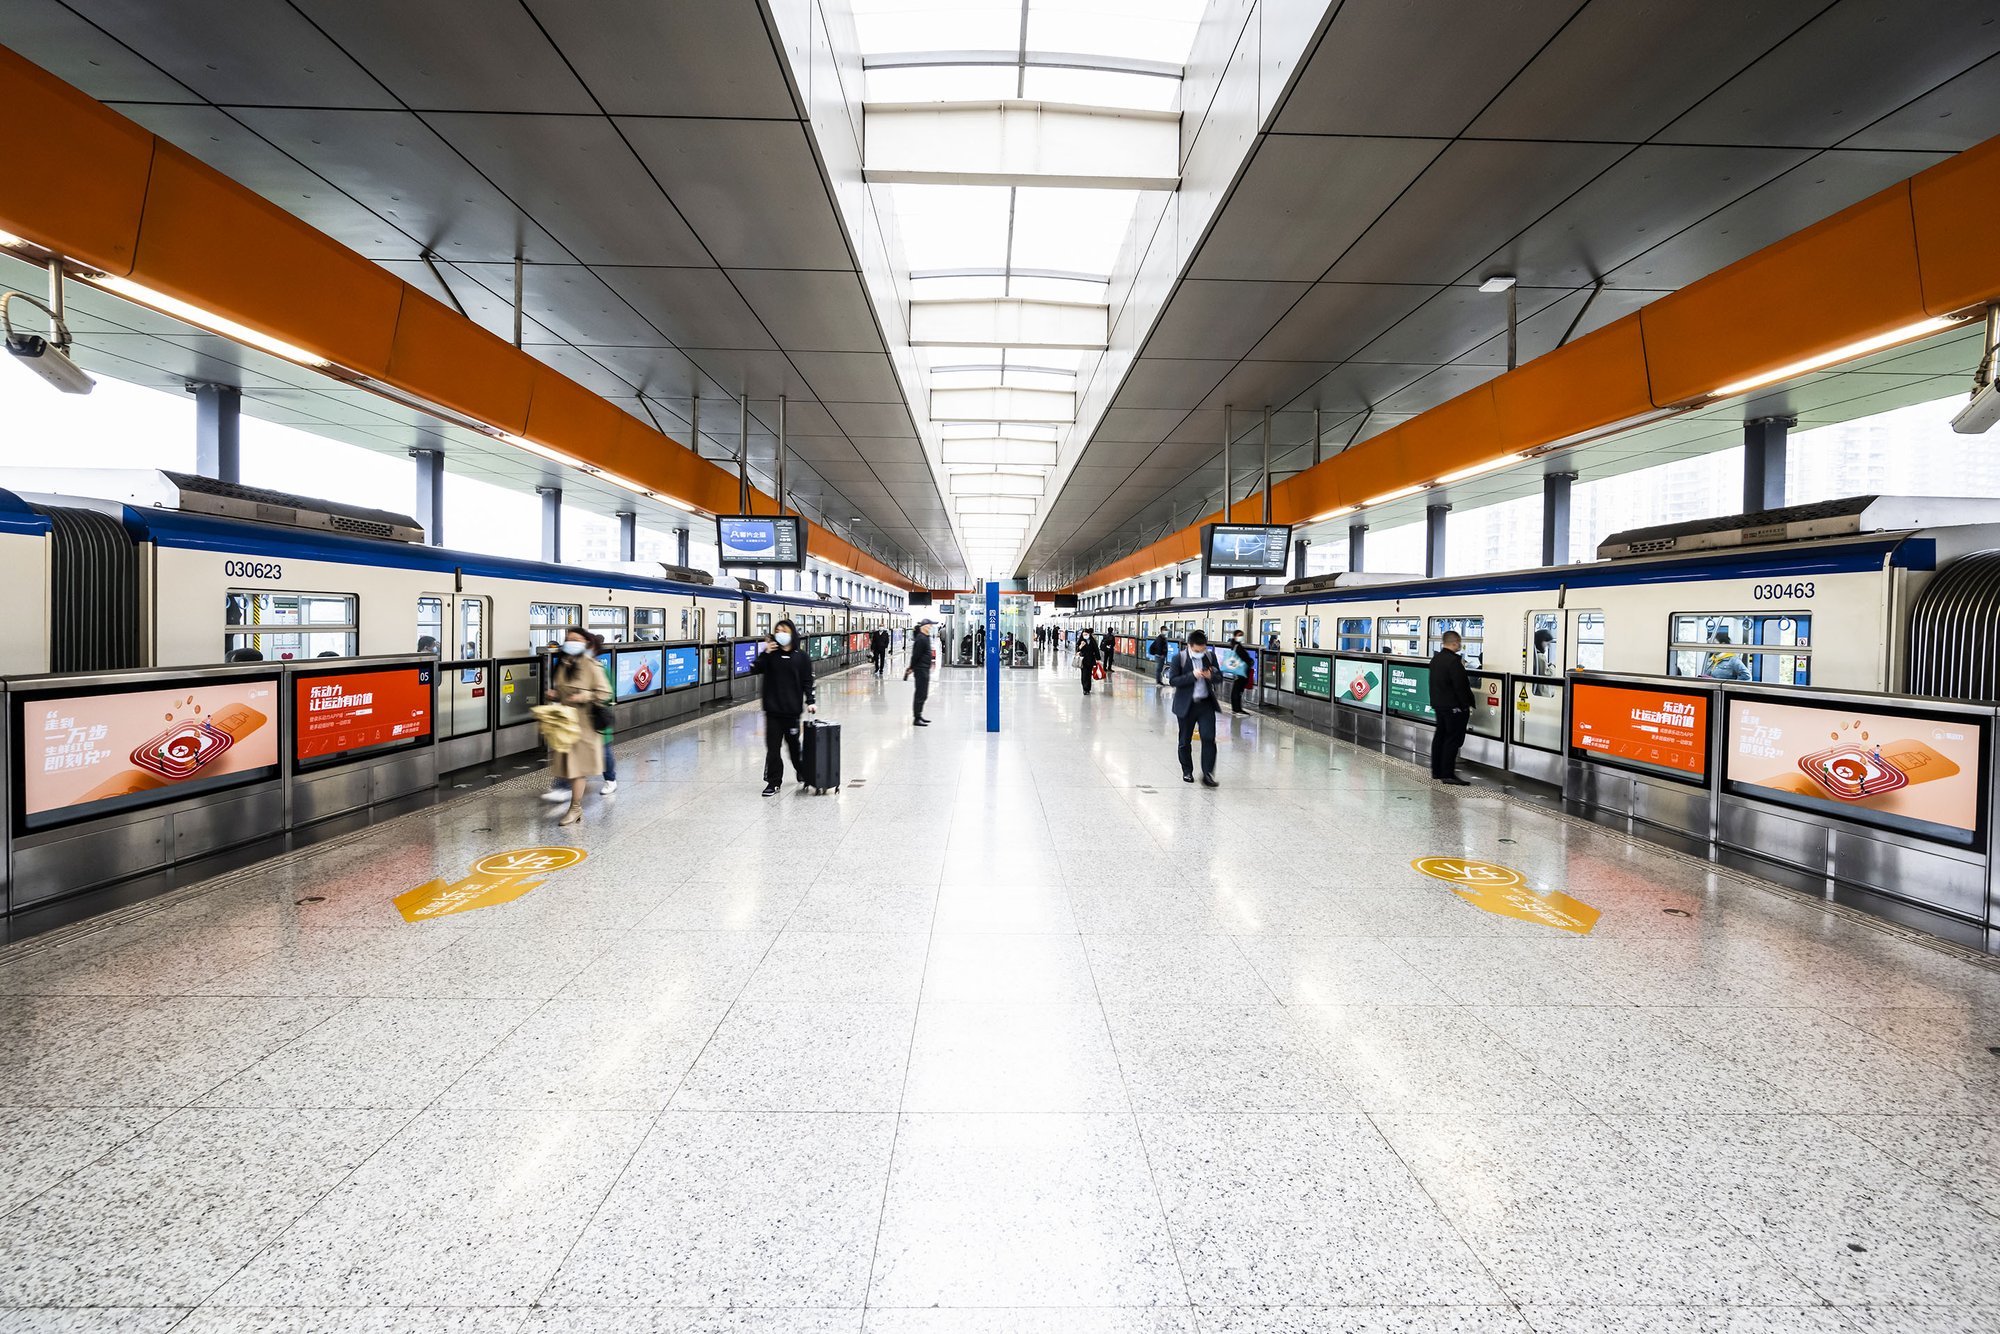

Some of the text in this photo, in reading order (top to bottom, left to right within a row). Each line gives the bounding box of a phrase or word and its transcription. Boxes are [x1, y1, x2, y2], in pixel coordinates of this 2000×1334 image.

[225, 560, 282, 579] 030623
[1754, 582, 1815, 600] 030463
[420, 672, 429, 681] 05
[310, 685, 342, 698] 乐动力
[309, 693, 373, 711] 让运动有价值
[1662, 701, 1695, 716] 乐动力
[1631, 708, 1695, 728] 让运动有价值
[45, 726, 107, 744] 一万步
[1741, 726, 1783, 740] 一万步
